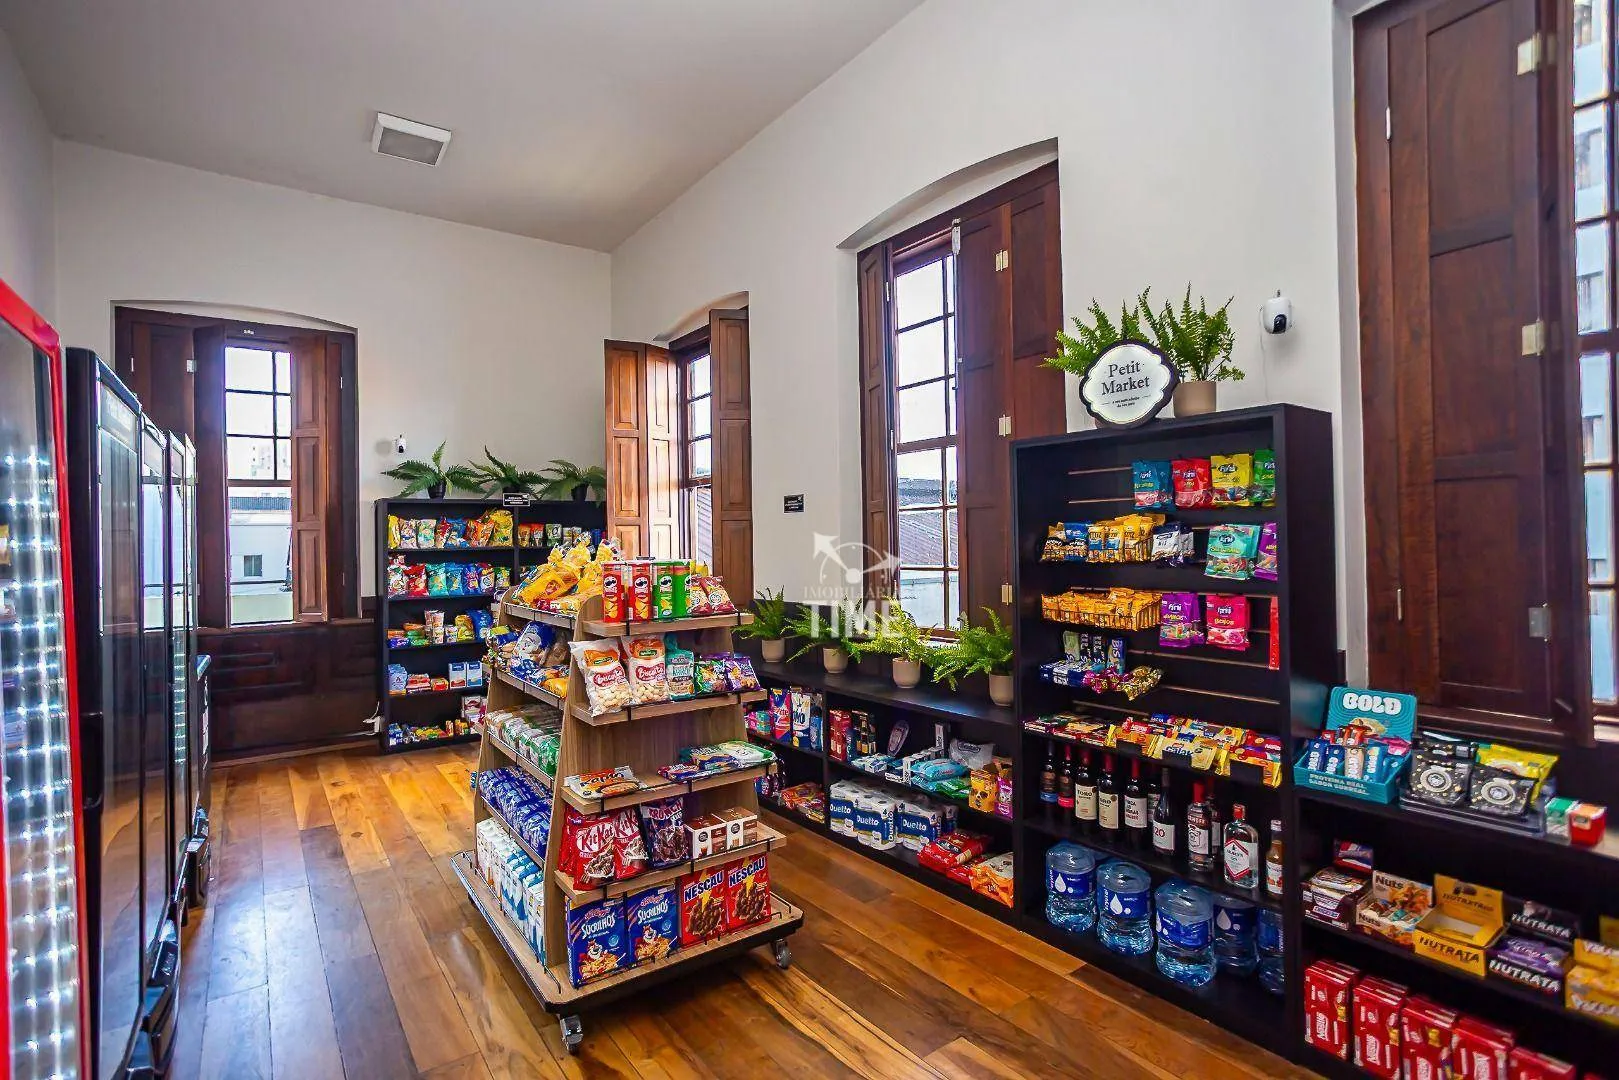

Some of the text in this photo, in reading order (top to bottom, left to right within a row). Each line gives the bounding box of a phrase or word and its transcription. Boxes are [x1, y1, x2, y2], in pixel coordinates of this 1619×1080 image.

[1108, 360, 1142, 378] Petit
[1101, 376, 1150, 396] Market
[1342, 692, 1402, 716] BOLD
[829, 802, 852, 814] Duetto
[856, 814, 880, 826] Duetto
[882, 808, 888, 816] 4
[902, 818, 928, 832] Duetto
[727, 856, 766, 888] NESCAU
[1375, 874, 1404, 889] Nuts
[684, 870, 725, 903] NESCAU
[637, 898, 670, 924] SUCRILHOS
[581, 911, 616, 940] SUCRILHOS
[1511, 913, 1571, 938] NUTRATA
[1419, 935, 1481, 963] NUTRATA
[1489, 959, 1561, 992] NUTRATA
